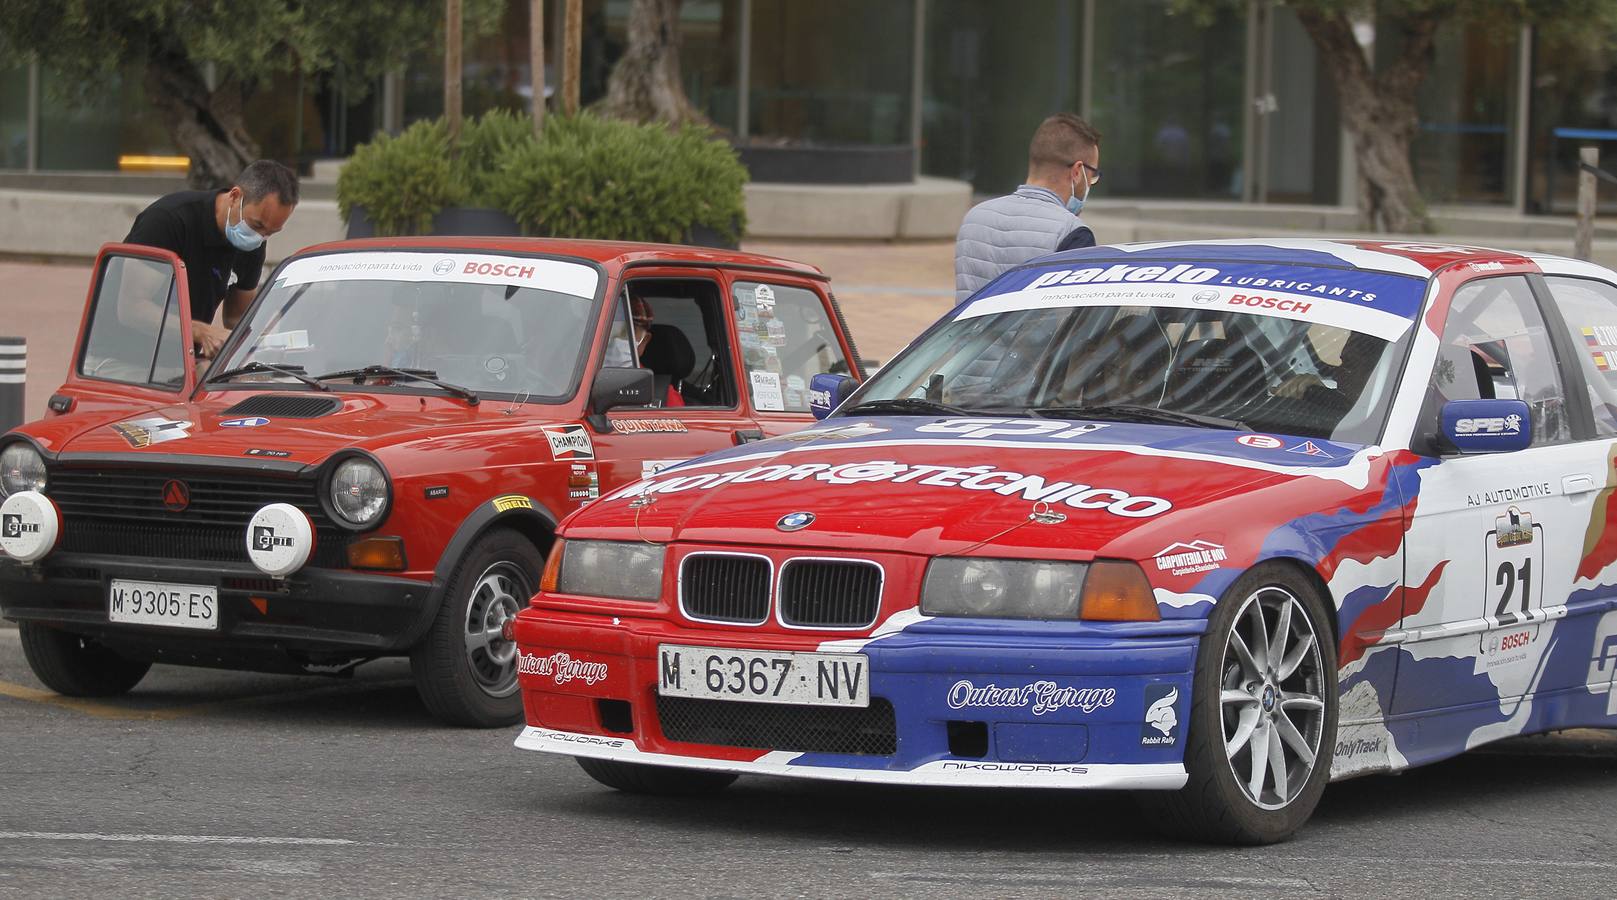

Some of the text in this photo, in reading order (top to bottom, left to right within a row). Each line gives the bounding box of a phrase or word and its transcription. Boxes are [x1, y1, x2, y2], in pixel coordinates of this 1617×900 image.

[463, 261, 536, 279] BOSCH
[1022, 264, 1377, 302] pakelo LUBRICANTS
[1105, 291, 1133, 300] para
[1227, 294, 1313, 314] BOSCH
[611, 419, 688, 434] QUINTANA
[1455, 417, 1505, 433] SPE
[551, 434, 588, 449] CHAMPION
[604, 463, 1173, 518] MOTOR TÉCNICO
[1467, 482, 1552, 507] AJ AUTOMOTIVE
[493, 495, 532, 513] PIRELLI
[1156, 551, 1203, 570] CARPINTERIA
[1201, 549, 1213, 563] DE
[1495, 557, 1534, 626] 21
[1501, 632, 1530, 650] BOSCH
[555, 652, 608, 686] Garage
[947, 680, 1116, 715] Outcast Garage
[1142, 736, 1176, 745] Rabbit Rally
